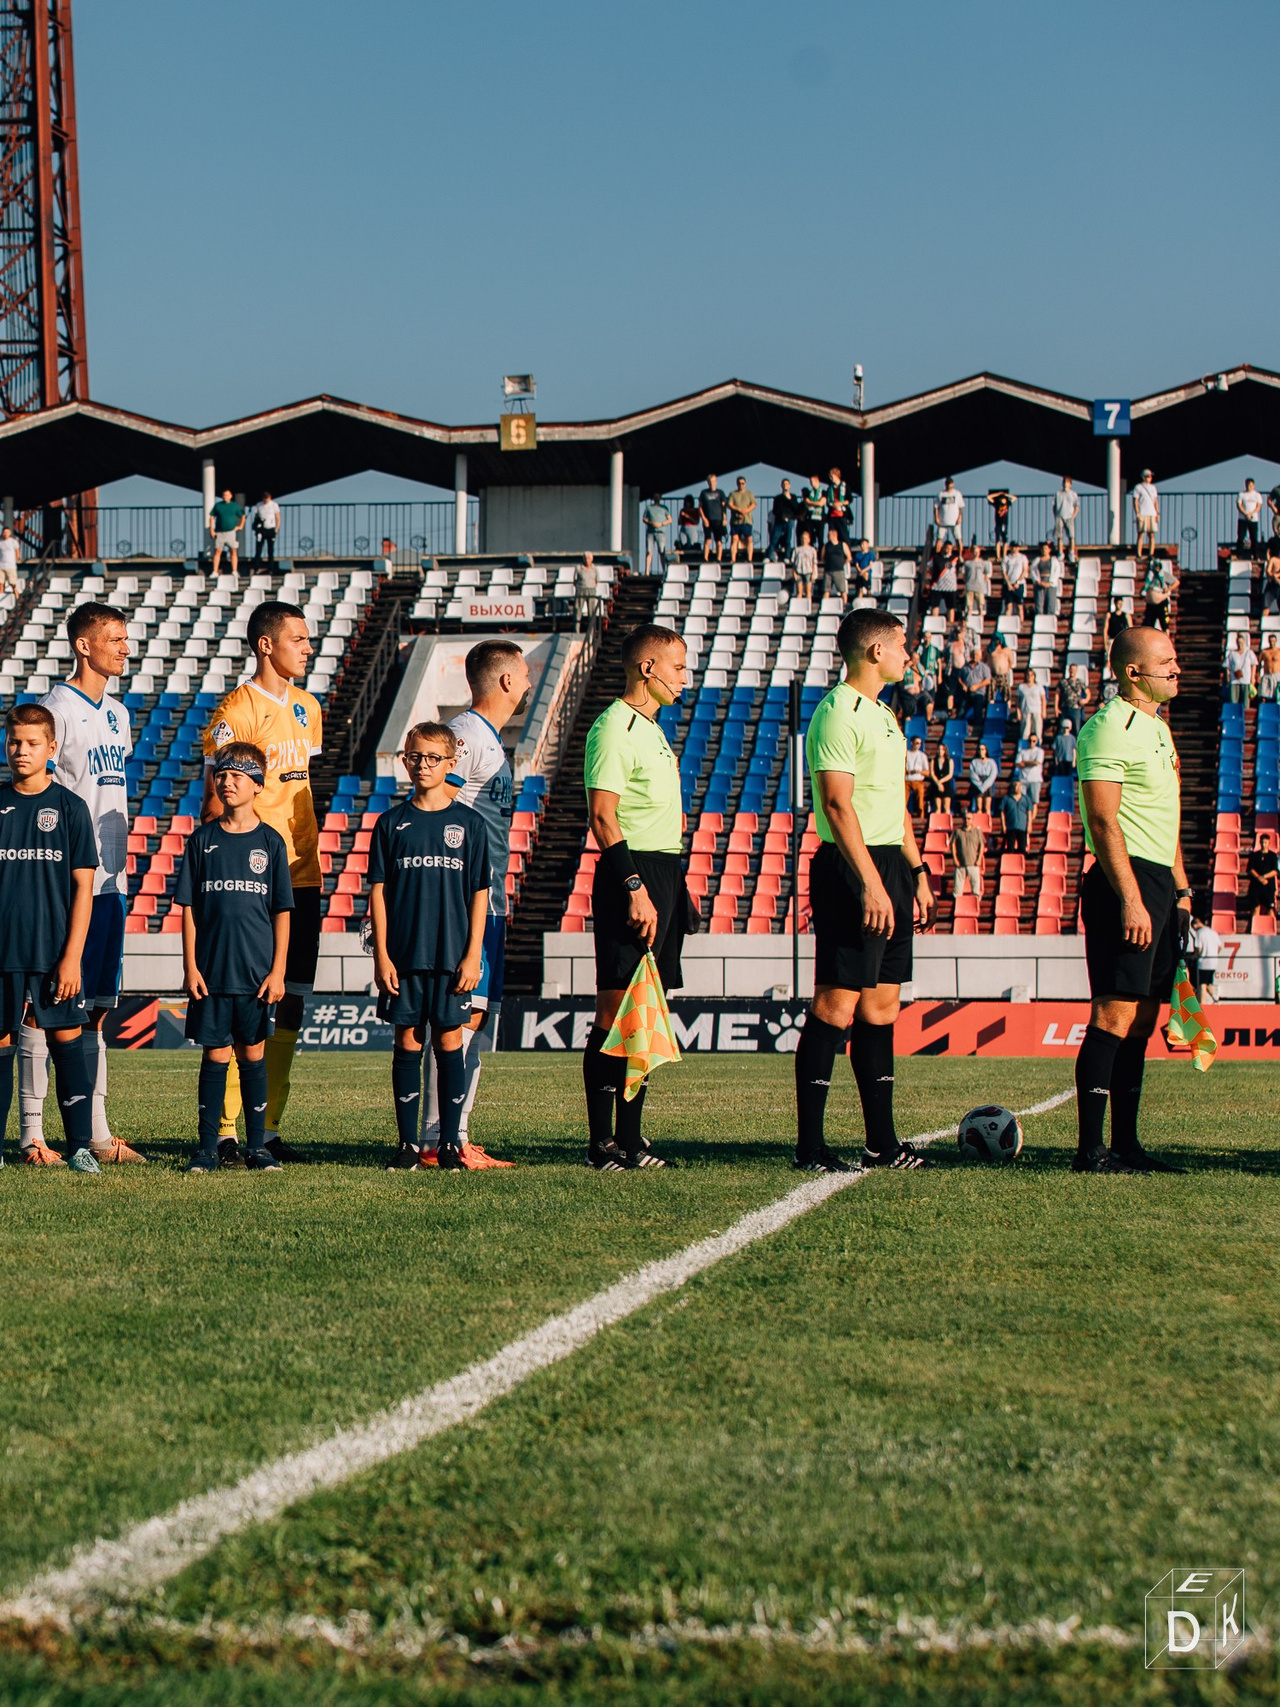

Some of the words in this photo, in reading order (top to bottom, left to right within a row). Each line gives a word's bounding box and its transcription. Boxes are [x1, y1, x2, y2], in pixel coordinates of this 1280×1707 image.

[1104, 403, 1121, 430] 7
[510, 419, 527, 445] 6
[470, 605, 526, 618] ВЫХОД
[1223, 942, 1241, 970] 7
[1214, 972, 1249, 982] сектор
[312, 1005, 391, 1025] #ЗА
